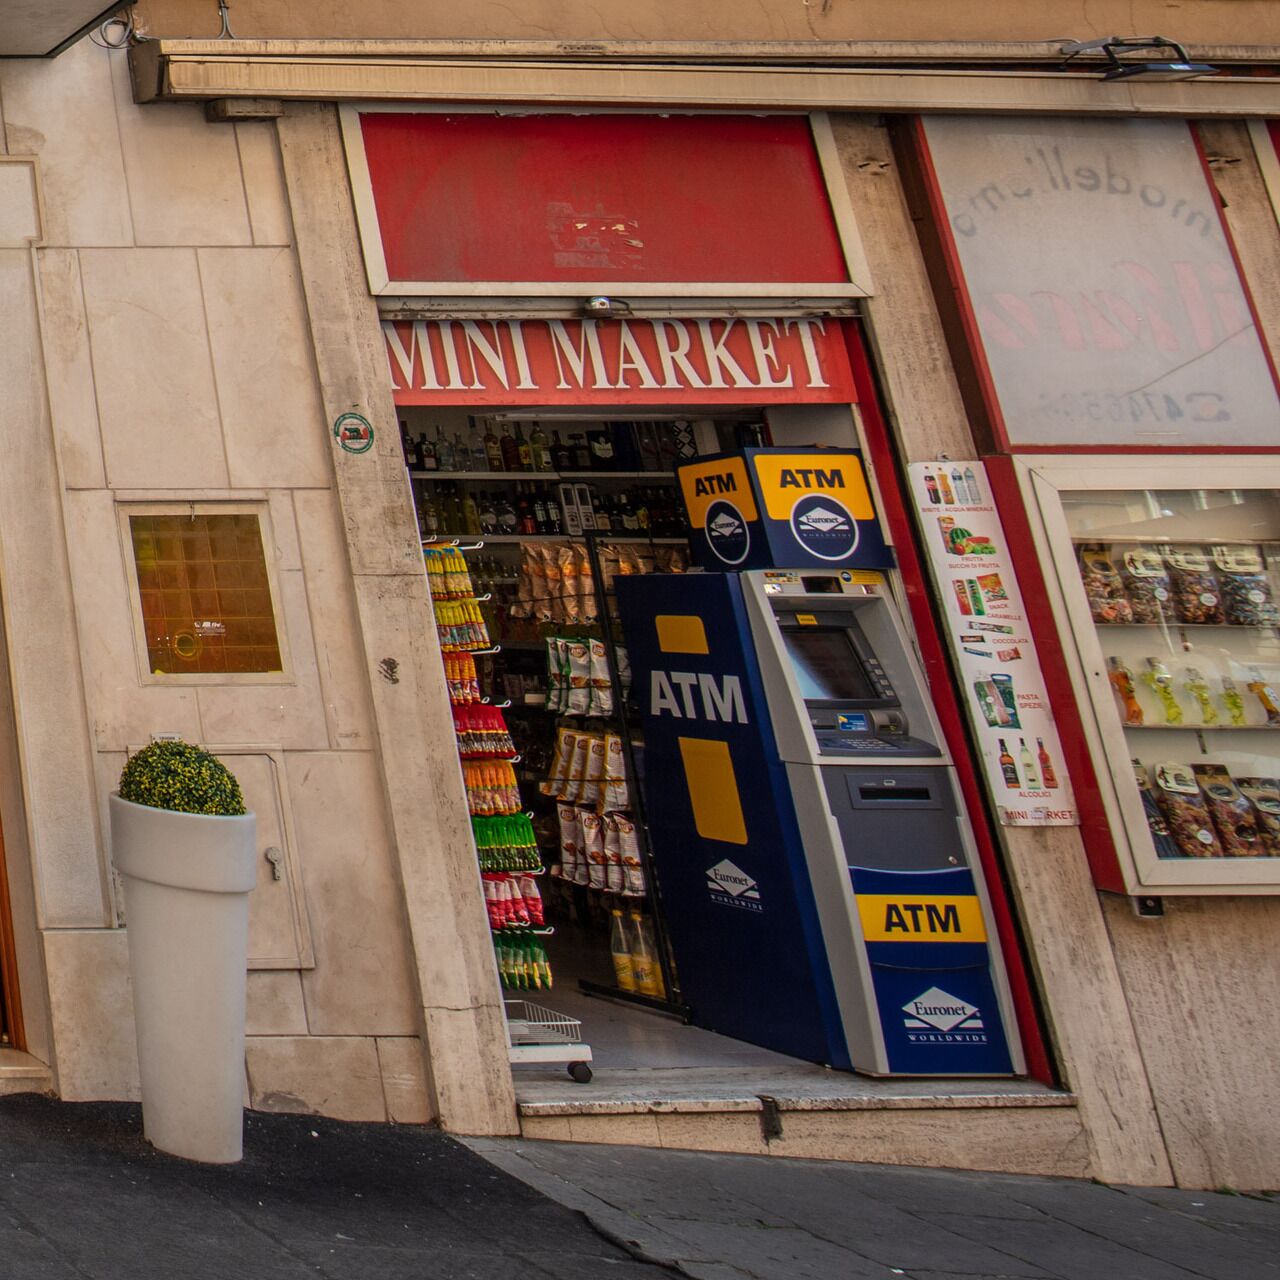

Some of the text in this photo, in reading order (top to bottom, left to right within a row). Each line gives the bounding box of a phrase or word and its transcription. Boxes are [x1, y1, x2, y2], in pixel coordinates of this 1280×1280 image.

[383, 319, 830, 391] MINI MARKET
[694, 472, 738, 497] ATM
[779, 469, 846, 489] ATM
[805, 515, 841, 525] Euronet
[650, 670, 749, 724] ATM
[1006, 811, 1028, 819] MINI
[713, 869, 749, 887] Euronet
[884, 904, 962, 933] ATM
[913, 1001, 968, 1016] Euronet
[908, 1034, 988, 1042] WORLDWIDE
